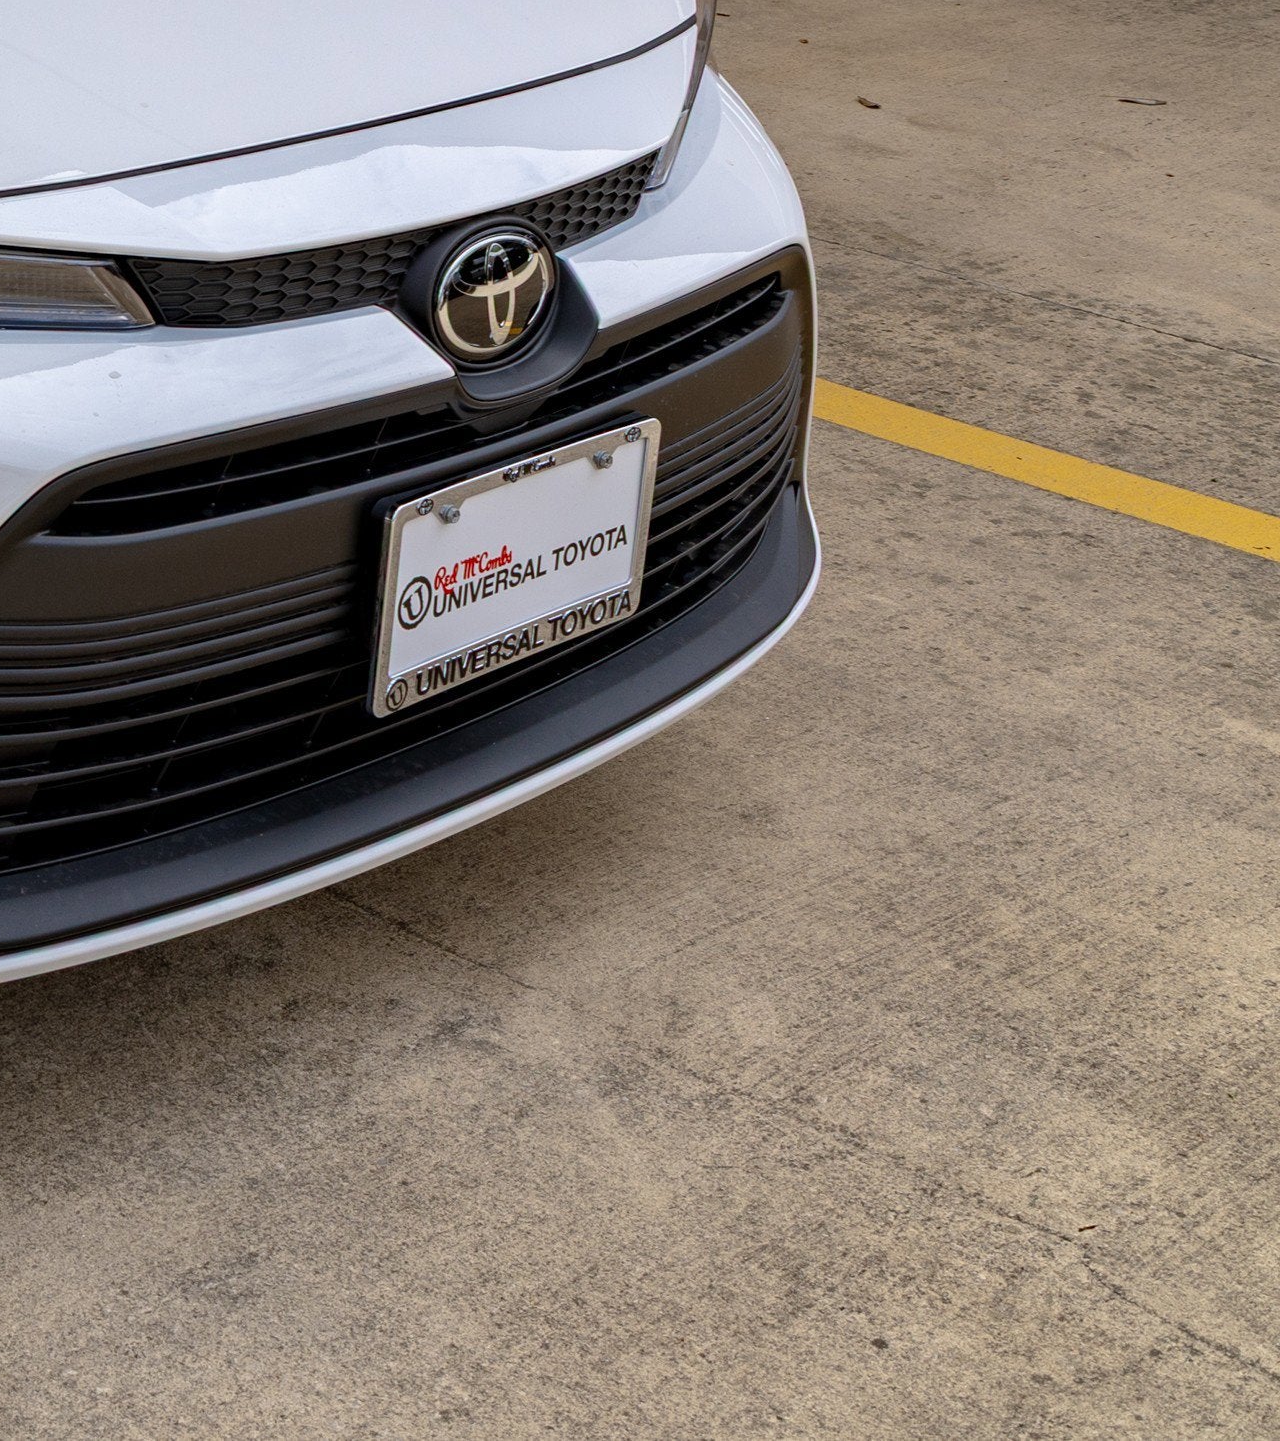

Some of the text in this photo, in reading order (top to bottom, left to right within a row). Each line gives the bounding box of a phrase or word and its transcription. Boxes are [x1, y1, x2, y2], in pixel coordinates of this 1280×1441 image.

[433, 524, 628, 618] UNIVERSAL TOYOTA
[434, 562, 458, 595] Red
[416, 623, 545, 696] UNIVERSAL
[547, 589, 631, 642] TOYOTA
